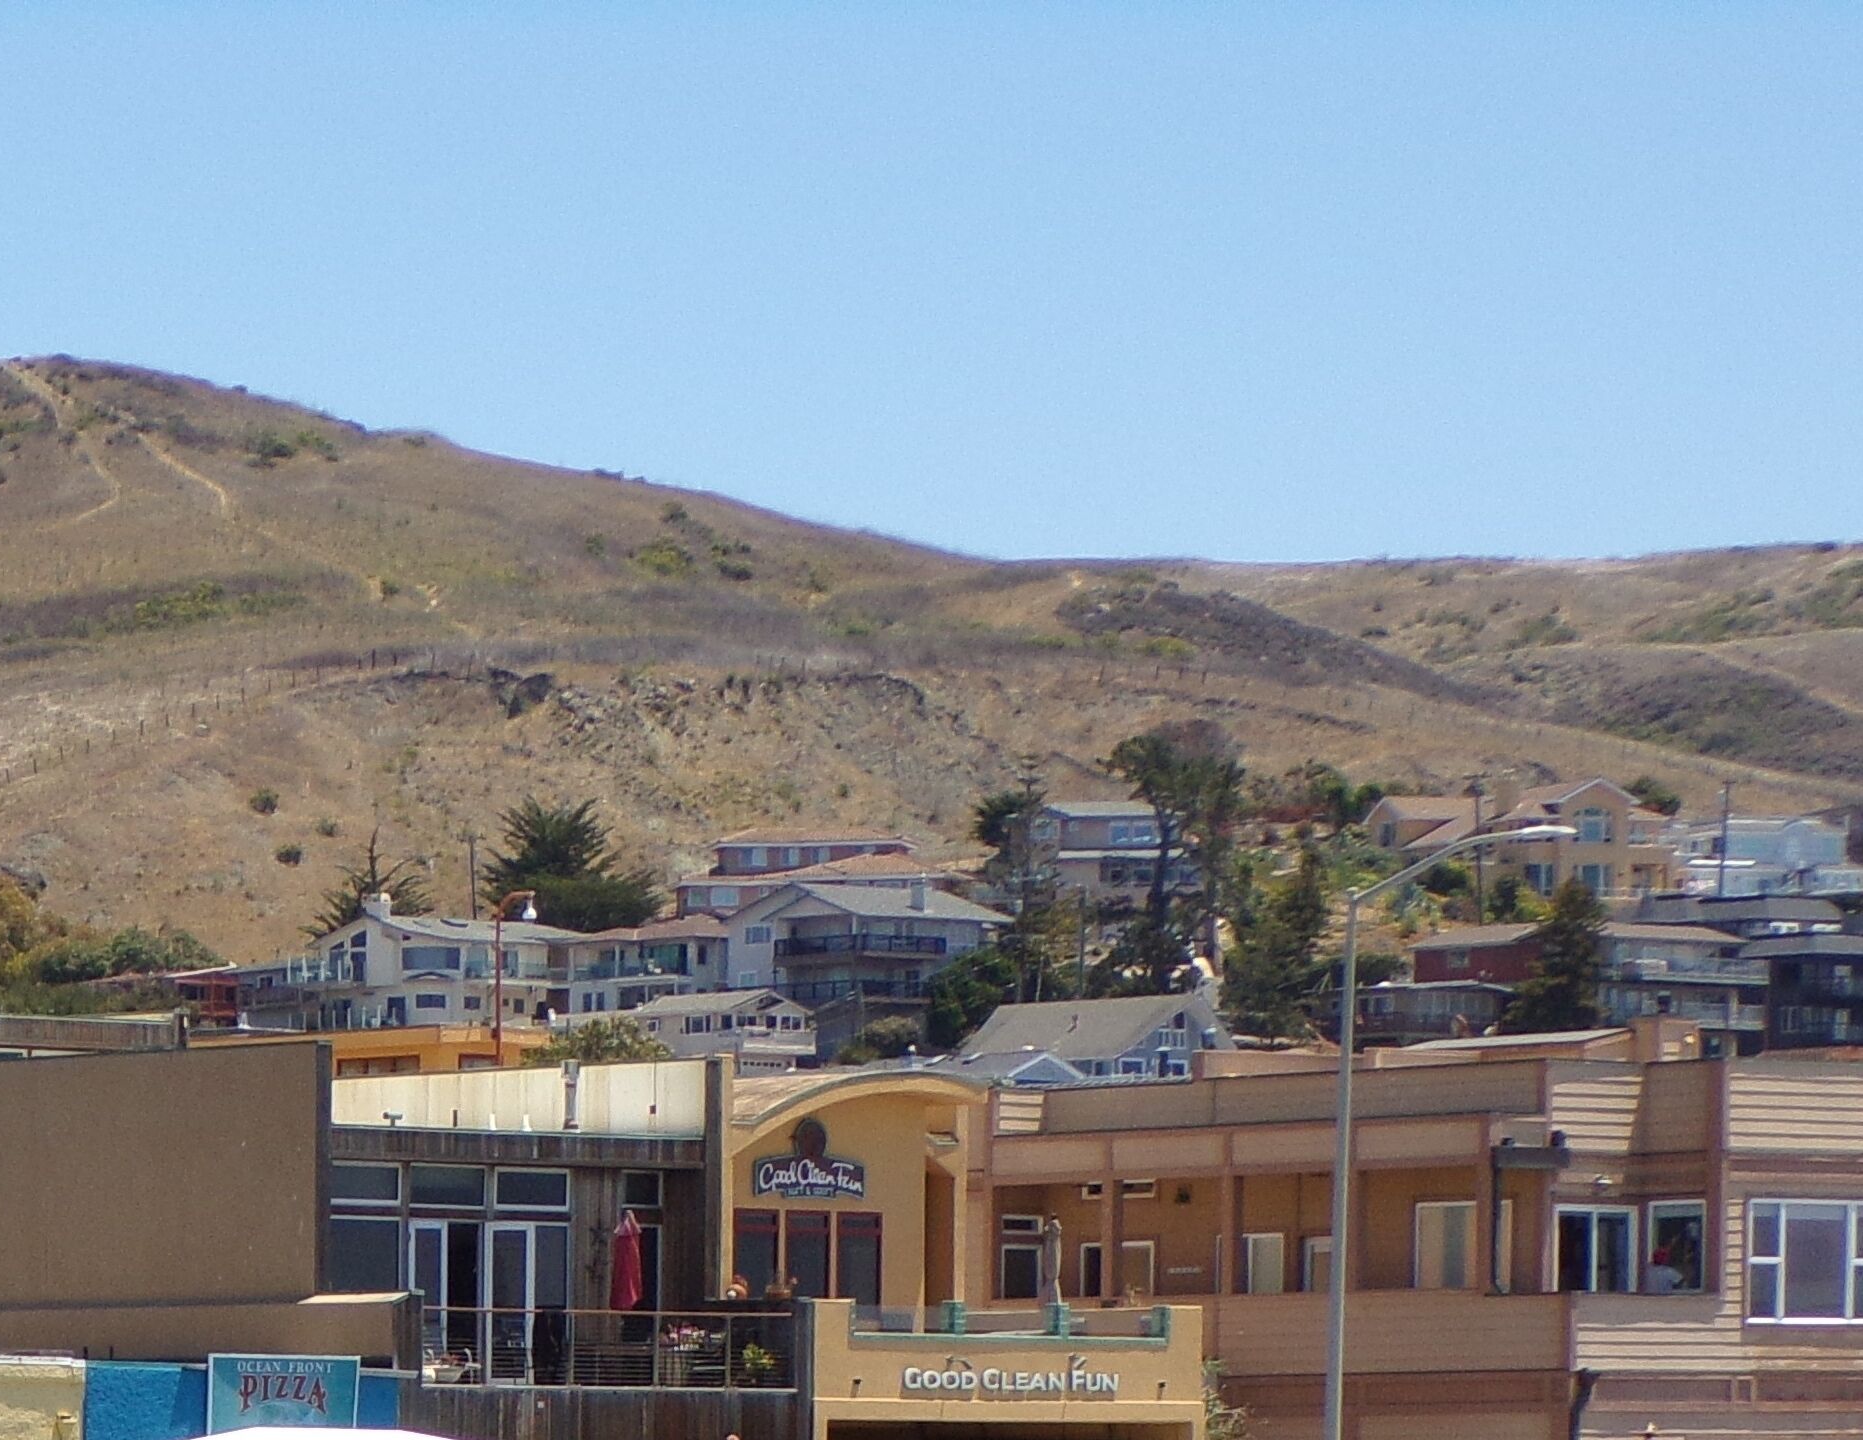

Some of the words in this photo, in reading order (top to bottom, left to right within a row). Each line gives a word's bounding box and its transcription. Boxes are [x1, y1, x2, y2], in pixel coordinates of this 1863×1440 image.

[759, 1161, 796, 1191] Good
[797, 1159, 835, 1185] Clean
[831, 1162, 863, 1192] Fun
[237, 1360, 281, 1373] OCEAN
[288, 1361, 335, 1373] FRONT
[904, 1367, 977, 1390] GOOD
[982, 1368, 1065, 1391] CLEAN
[1071, 1369, 1120, 1392] FUN
[239, 1373, 327, 1415] PIZZA
